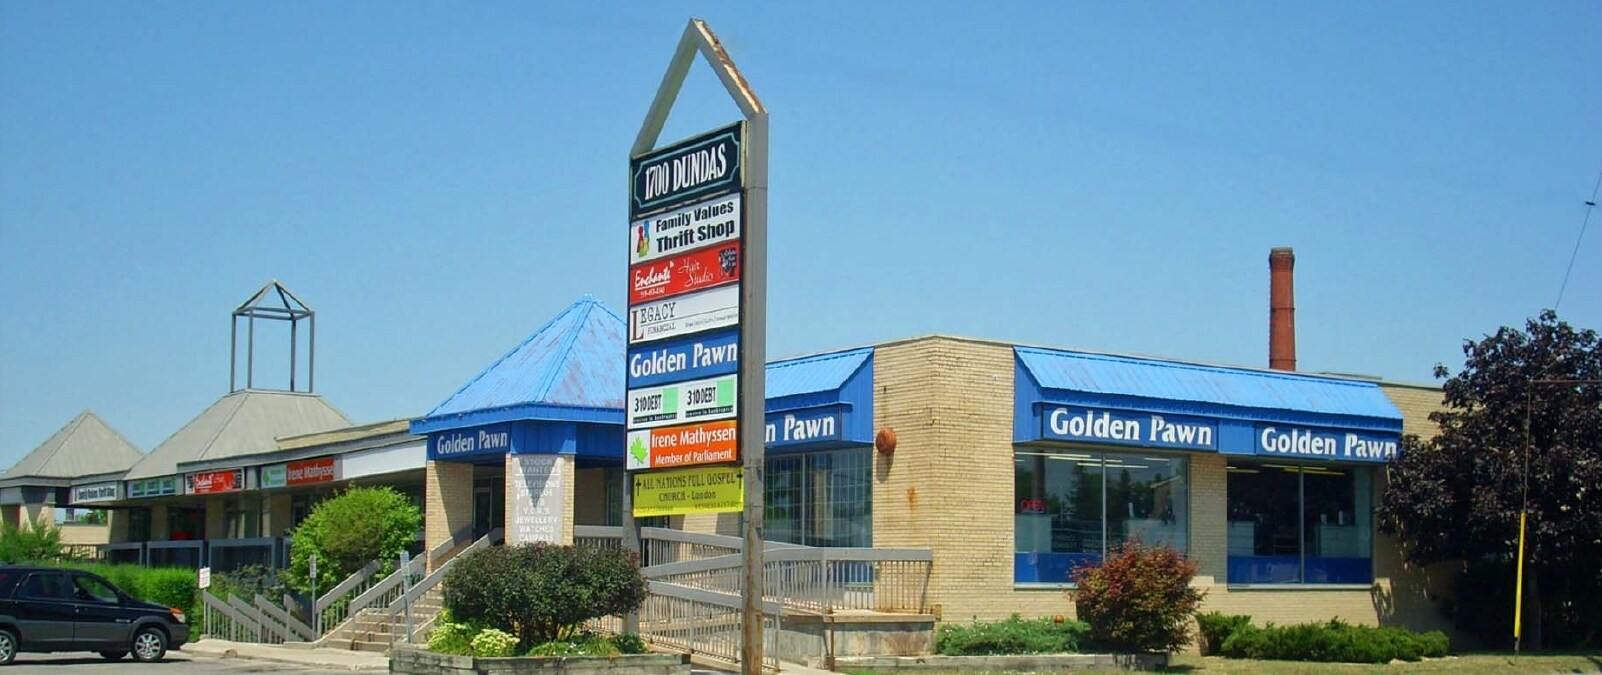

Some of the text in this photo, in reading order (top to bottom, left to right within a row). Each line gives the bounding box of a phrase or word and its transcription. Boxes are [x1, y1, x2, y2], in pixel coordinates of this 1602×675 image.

[644, 143, 727, 200] 1700 DUNDAS
[656, 201, 734, 233] Family Values
[656, 220, 735, 253] Thrift Shop
[678, 257, 701, 274] Hair
[685, 267, 714, 288] Studio
[647, 322, 676, 335] FINANCIAL
[630, 343, 738, 378] Golden Pawn
[652, 427, 737, 449] Irene Mathyssen
[783, 414, 835, 442] Pawn
[1050, 407, 1212, 446] Golden Pawn
[437, 430, 508, 455] Golden Pawn
[1261, 426, 1397, 459] Golden Pawn
[654, 447, 732, 466] Member of Parliament
[642, 472, 735, 489] ALL NATIONS FULL GOSPEL
[659, 491, 686, 502] CHURCH
[691, 490, 716, 501] London
